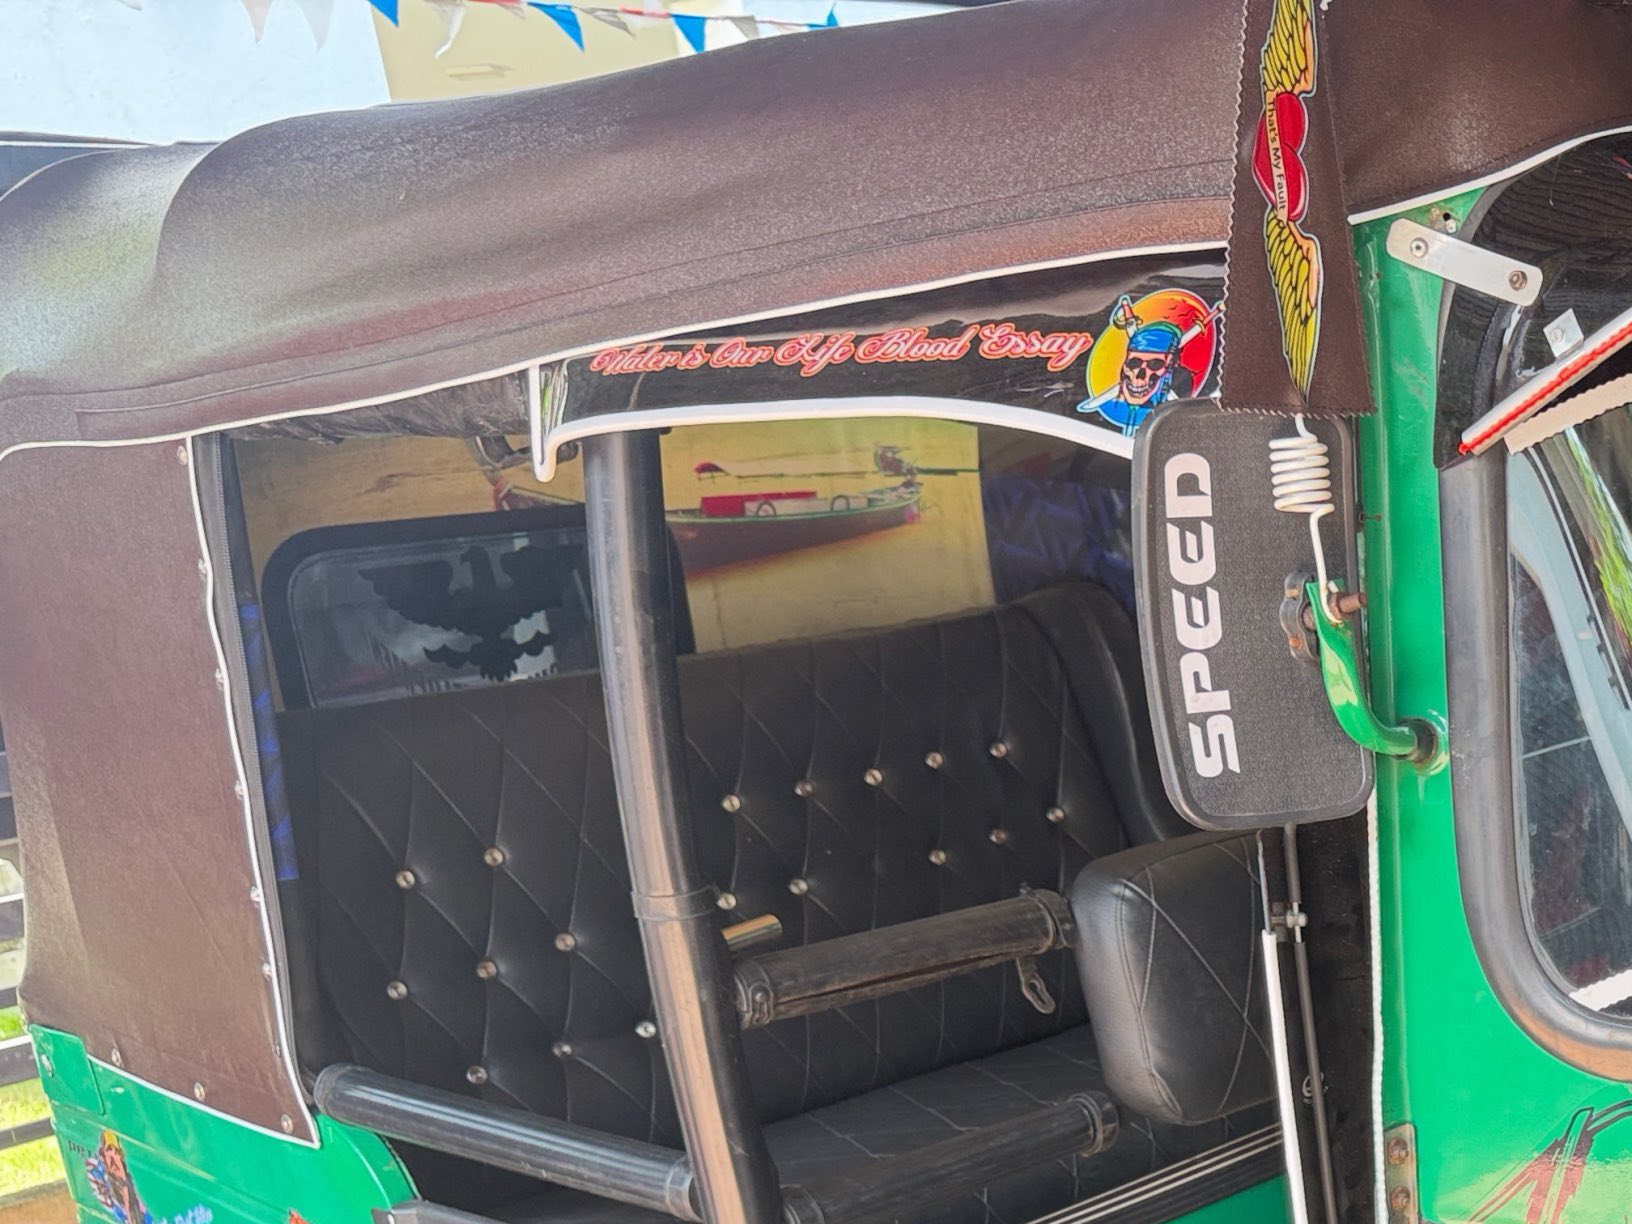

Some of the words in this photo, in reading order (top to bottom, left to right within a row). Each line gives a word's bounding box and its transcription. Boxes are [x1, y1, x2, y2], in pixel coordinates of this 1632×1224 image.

[1272, 147, 1281, 169] My
[1275, 174, 1287, 210] Fault
[677, 340, 709, 371] is
[709, 337, 774, 369] Our
[773, 331, 856, 378] Life
[856, 324, 981, 363] Blood
[978, 322, 1094, 372] Essay
[1164, 452, 1241, 778] SPEED
